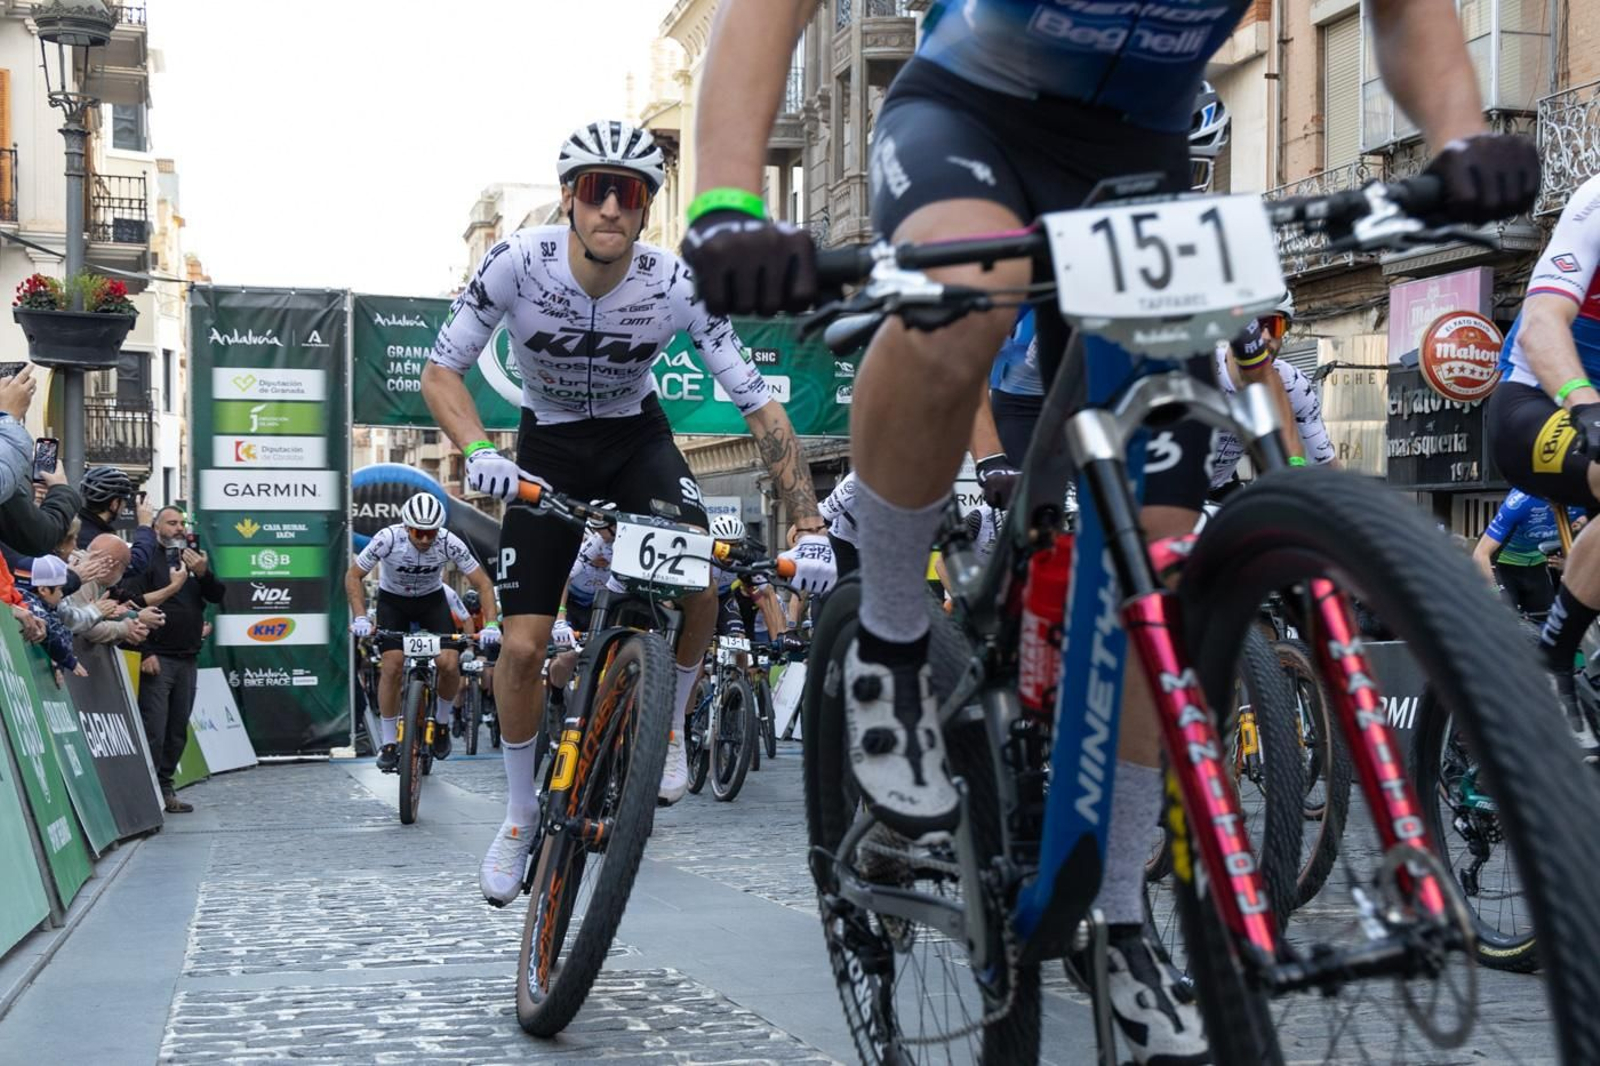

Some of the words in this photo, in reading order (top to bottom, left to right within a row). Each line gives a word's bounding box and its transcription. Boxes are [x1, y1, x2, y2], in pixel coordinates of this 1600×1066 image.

[540, 241, 557, 257] SLP
[1090, 206, 1235, 292] 15-1
[638, 254, 657, 272] SLP
[374, 312, 429, 329] Andalucía
[619, 316, 656, 326] DMT
[208, 327, 284, 347] Andalucía
[387, 345, 434, 358] GRANA
[524, 327, 658, 364] KTM
[1435, 342, 1500, 363] Mahou
[755, 352, 777, 363] SHC
[386, 362, 421, 375] JAÉN
[258, 379, 302, 389] Diputación
[270, 386, 305, 394] Granada
[387, 377, 421, 392] CÓRD
[1388, 424, 1469, 458] marisquería
[261, 445, 304, 454] Diputación
[1450, 460, 1479, 481] 1974
[223, 483, 317, 497] GARMIN
[351, 503, 403, 518] GARM
[262, 523, 280, 532] CAJA
[281, 523, 309, 532] RURAL
[276, 530, 295, 539] JAÉN
[639, 532, 688, 576] 6-2
[795, 551, 832, 563] RIDE
[395, 565, 440, 575] KTM
[251, 588, 292, 601] NDL
[409, 638, 434, 653] 29-1
[727, 637, 745, 648] 13-1
[244, 667, 291, 680] Andalucía
[243, 678, 265, 687] BIKE
[265, 678, 291, 687] RACE
[79, 711, 138, 758] GARMIN
[1158, 667, 1269, 915] MANITOU
